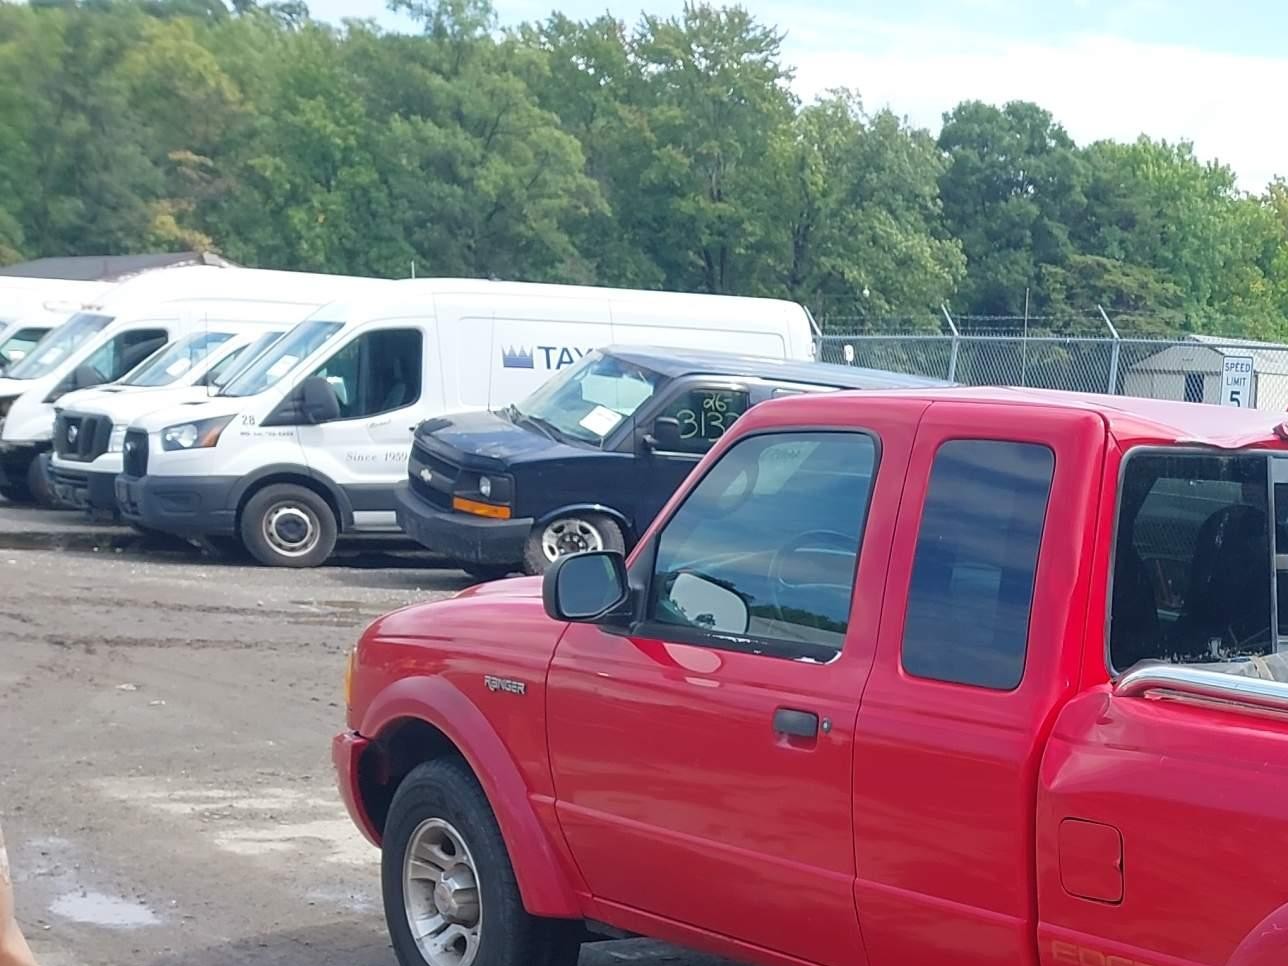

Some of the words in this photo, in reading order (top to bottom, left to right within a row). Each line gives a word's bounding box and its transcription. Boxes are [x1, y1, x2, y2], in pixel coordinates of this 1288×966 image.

[1225, 362, 1251, 373] SPEED
[1227, 376, 1247, 386] LIMIT
[1230, 390, 1241, 408] 5
[676, 409, 740, 442] 313
[484, 674, 525, 695] RANGER
